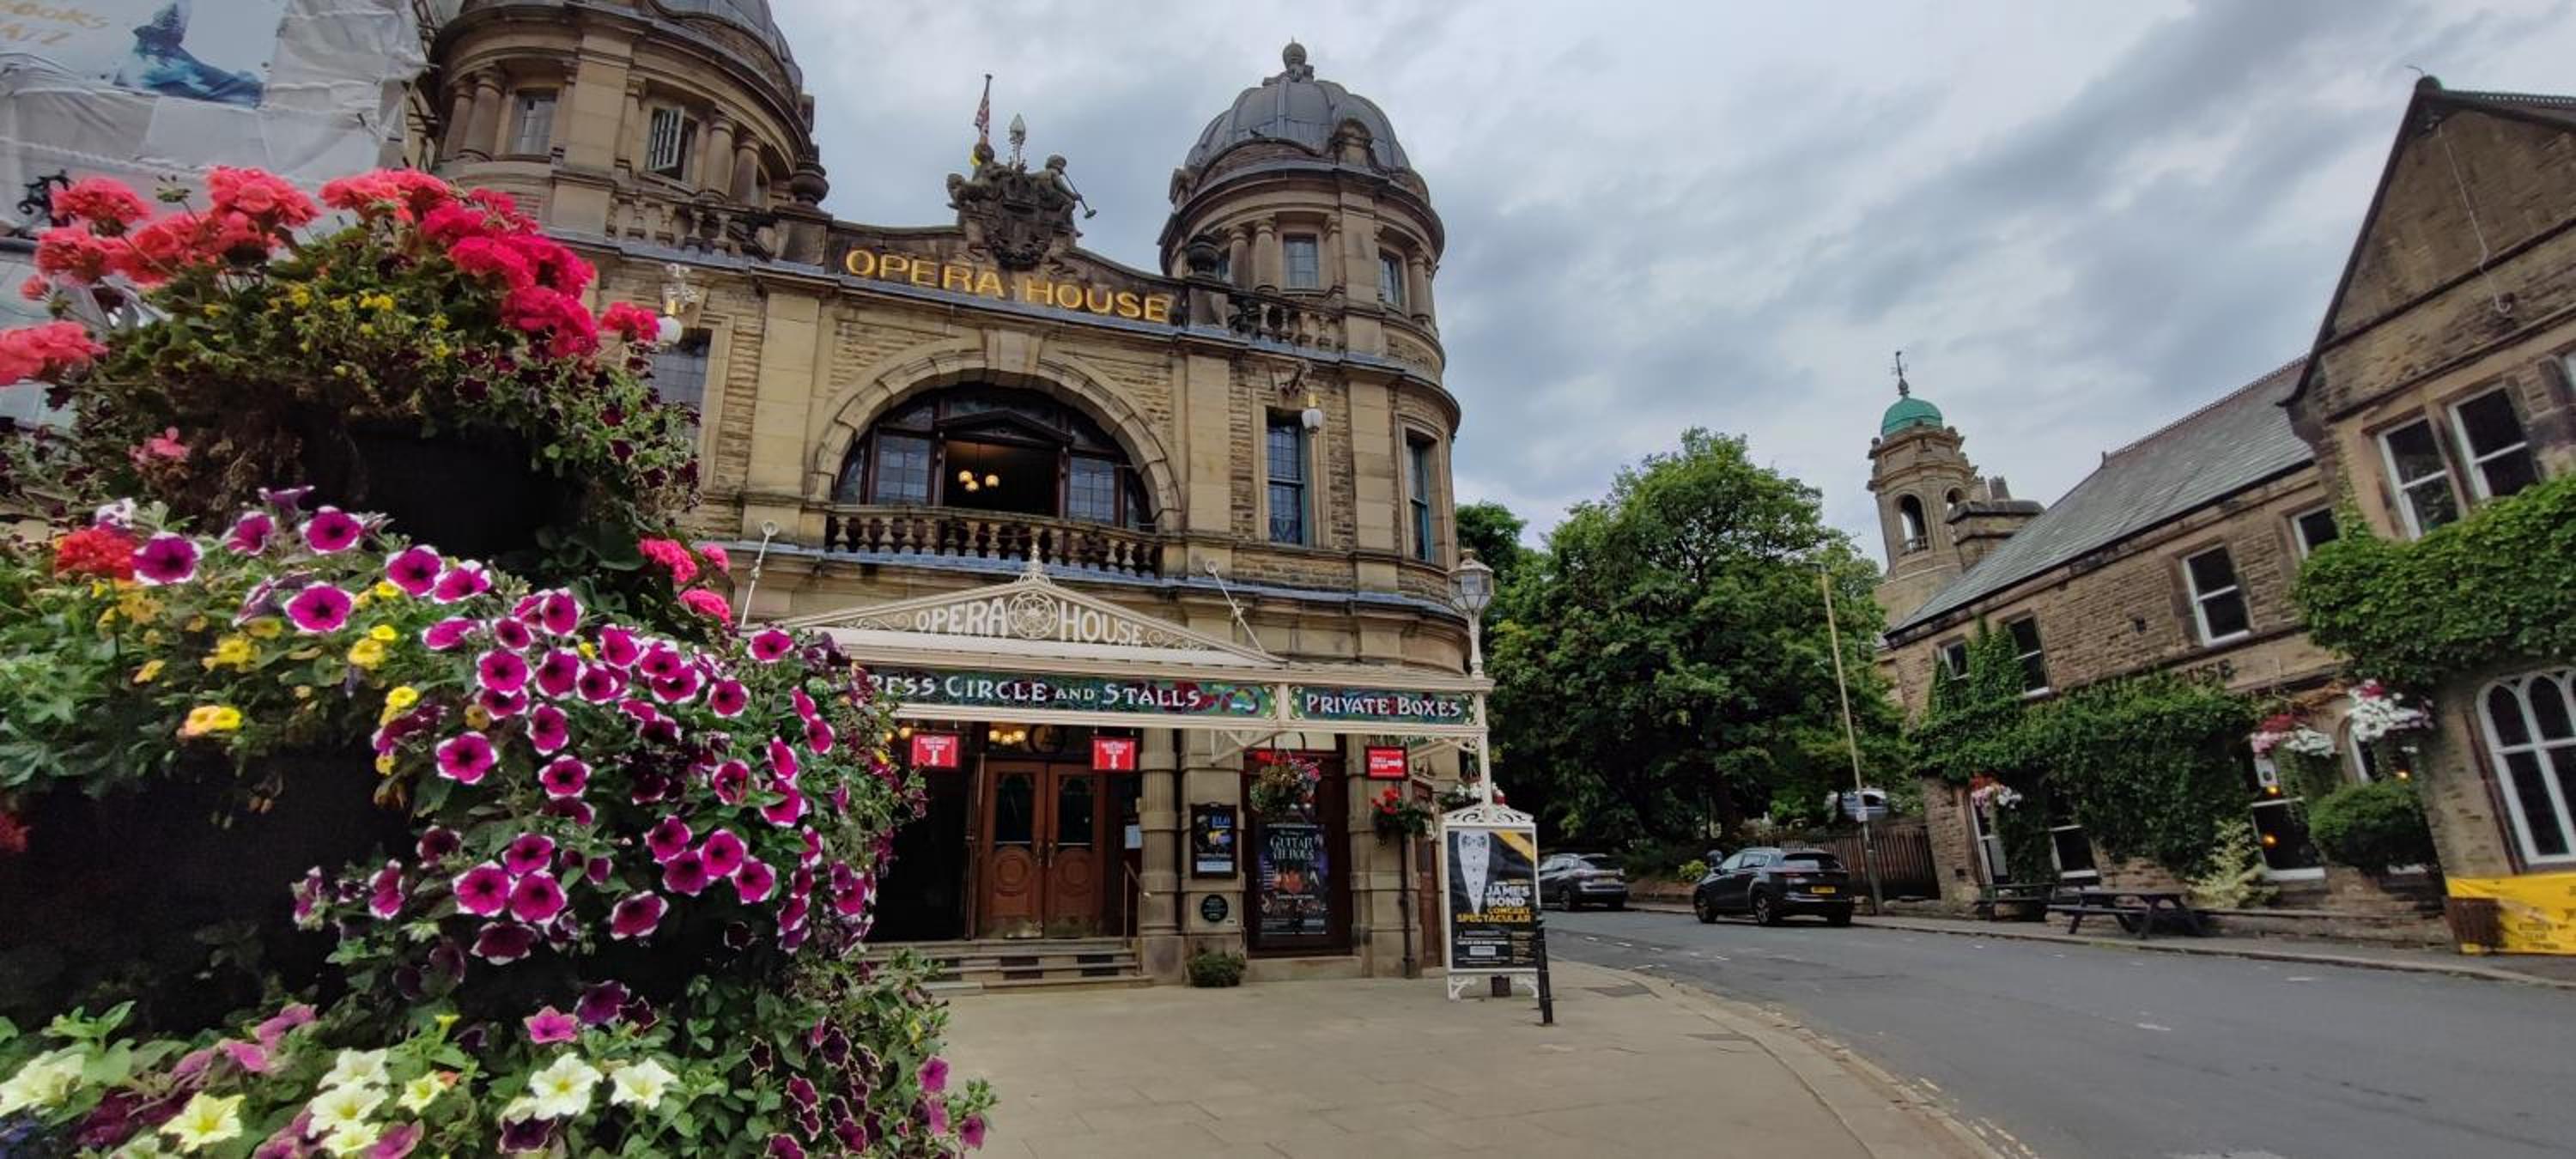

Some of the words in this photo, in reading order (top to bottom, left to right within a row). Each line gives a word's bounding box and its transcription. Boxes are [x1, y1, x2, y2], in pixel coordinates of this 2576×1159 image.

[846, 248, 1005, 299] OPERA
[1025, 279, 1170, 322] HOUSE
[915, 598, 1008, 637] OPERA
[1060, 600, 1143, 645] HOUSE
[945, 676, 1047, 701] CIRCLE
[1054, 687, 1095, 701] AND
[1101, 683, 1201, 707] STALLS
[1306, 694, 1390, 714] PRIVATE
[1397, 695, 1461, 717] BOXES
[1485, 885, 1530, 897] JAMES
[1486, 897, 1525, 907] BOND
[1456, 913, 1531, 923] SPECTACULAR
